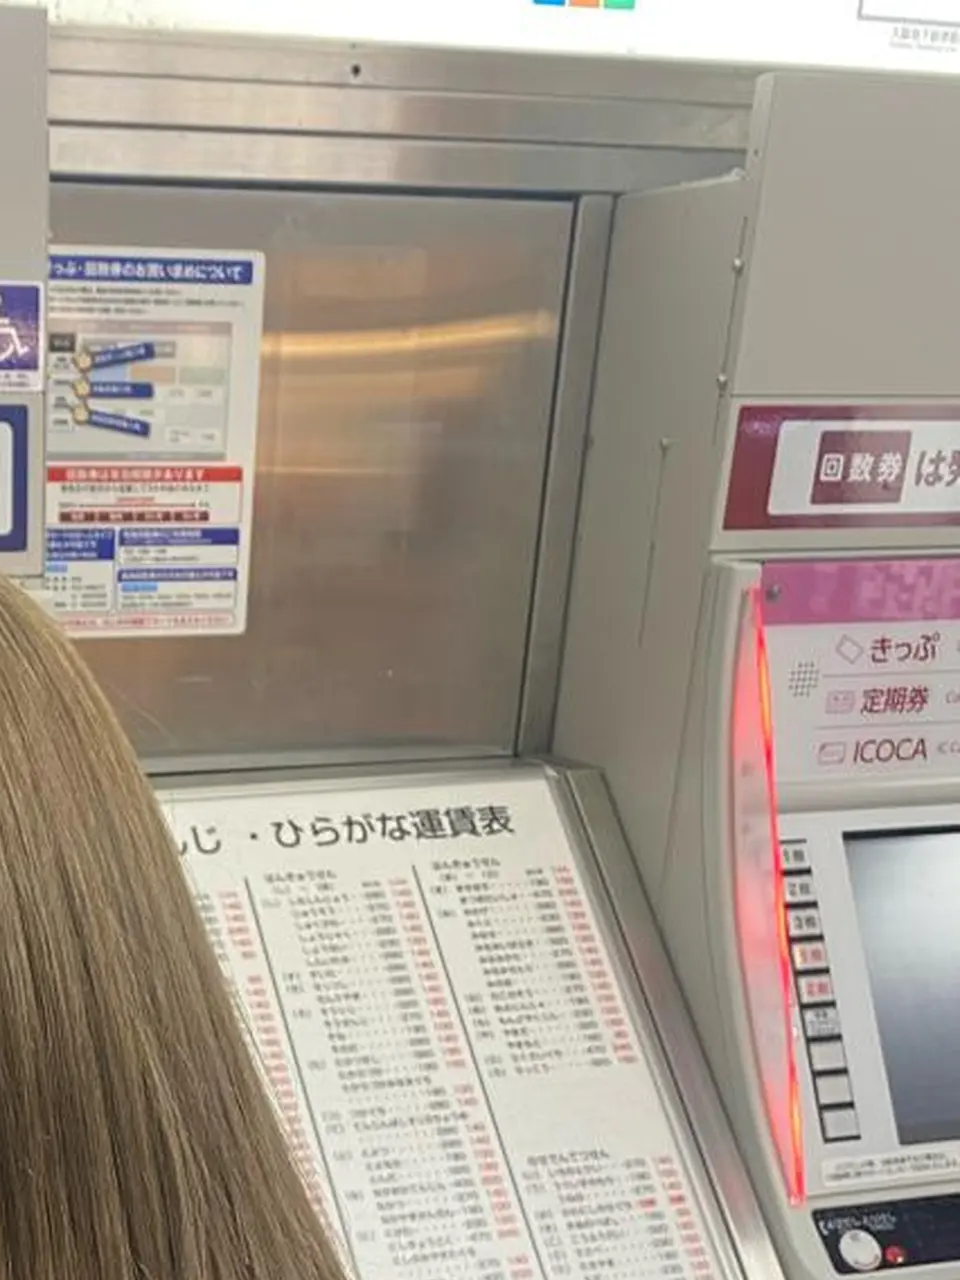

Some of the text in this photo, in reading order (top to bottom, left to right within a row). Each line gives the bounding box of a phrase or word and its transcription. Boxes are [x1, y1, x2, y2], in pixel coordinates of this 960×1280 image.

[819, 452, 903, 482] 回数券
[870, 631, 941, 663] きっぷ
[860, 685, 930, 714] 定期券
[852, 737, 929, 765] ICOCA
